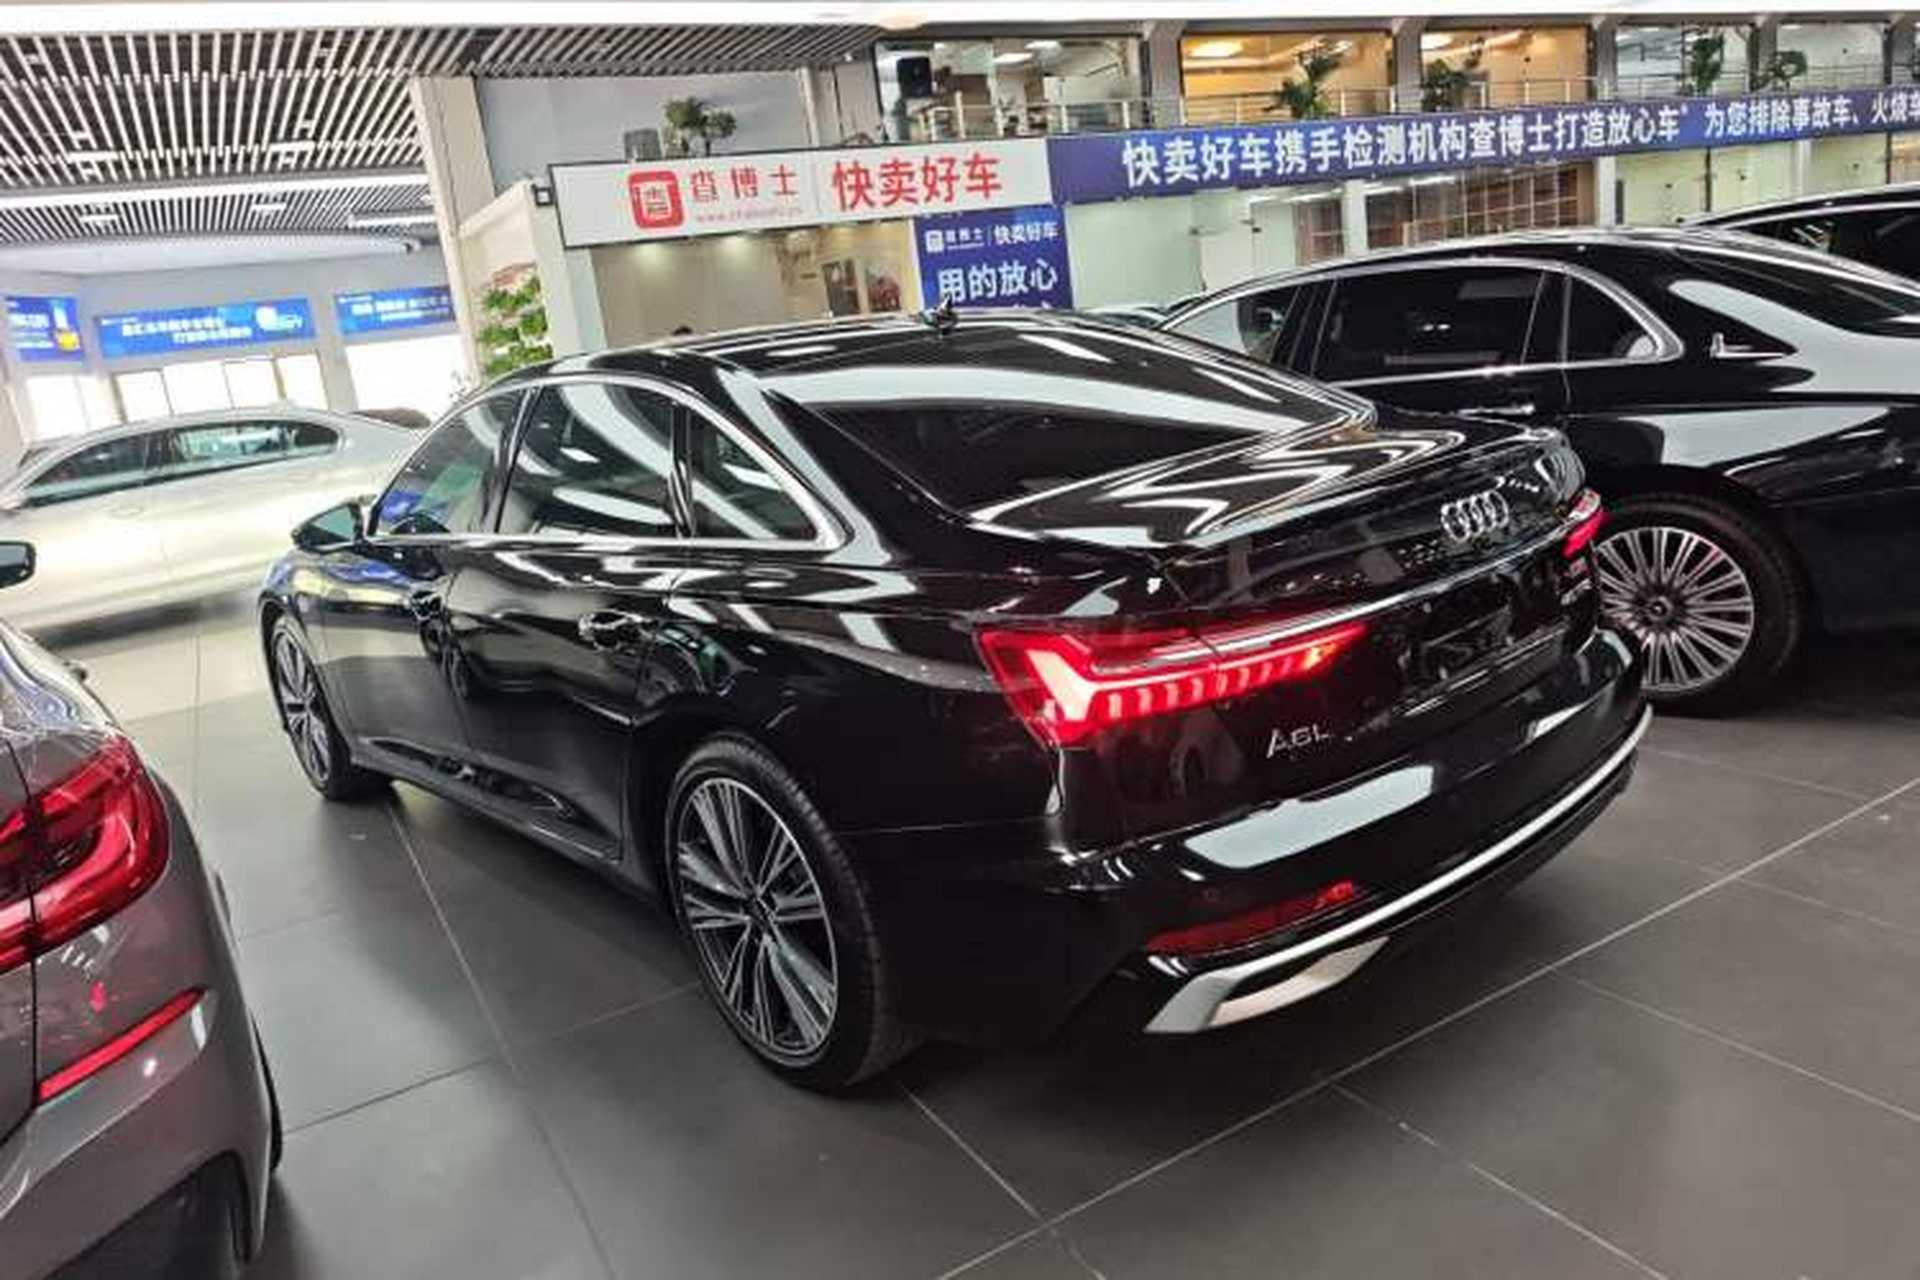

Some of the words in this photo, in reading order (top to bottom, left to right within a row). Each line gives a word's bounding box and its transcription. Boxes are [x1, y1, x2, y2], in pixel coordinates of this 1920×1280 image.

[832, 152, 1003, 211] 快卖好车
[937, 257, 1058, 303] 用的放心
[1266, 723, 1329, 759] A6L
